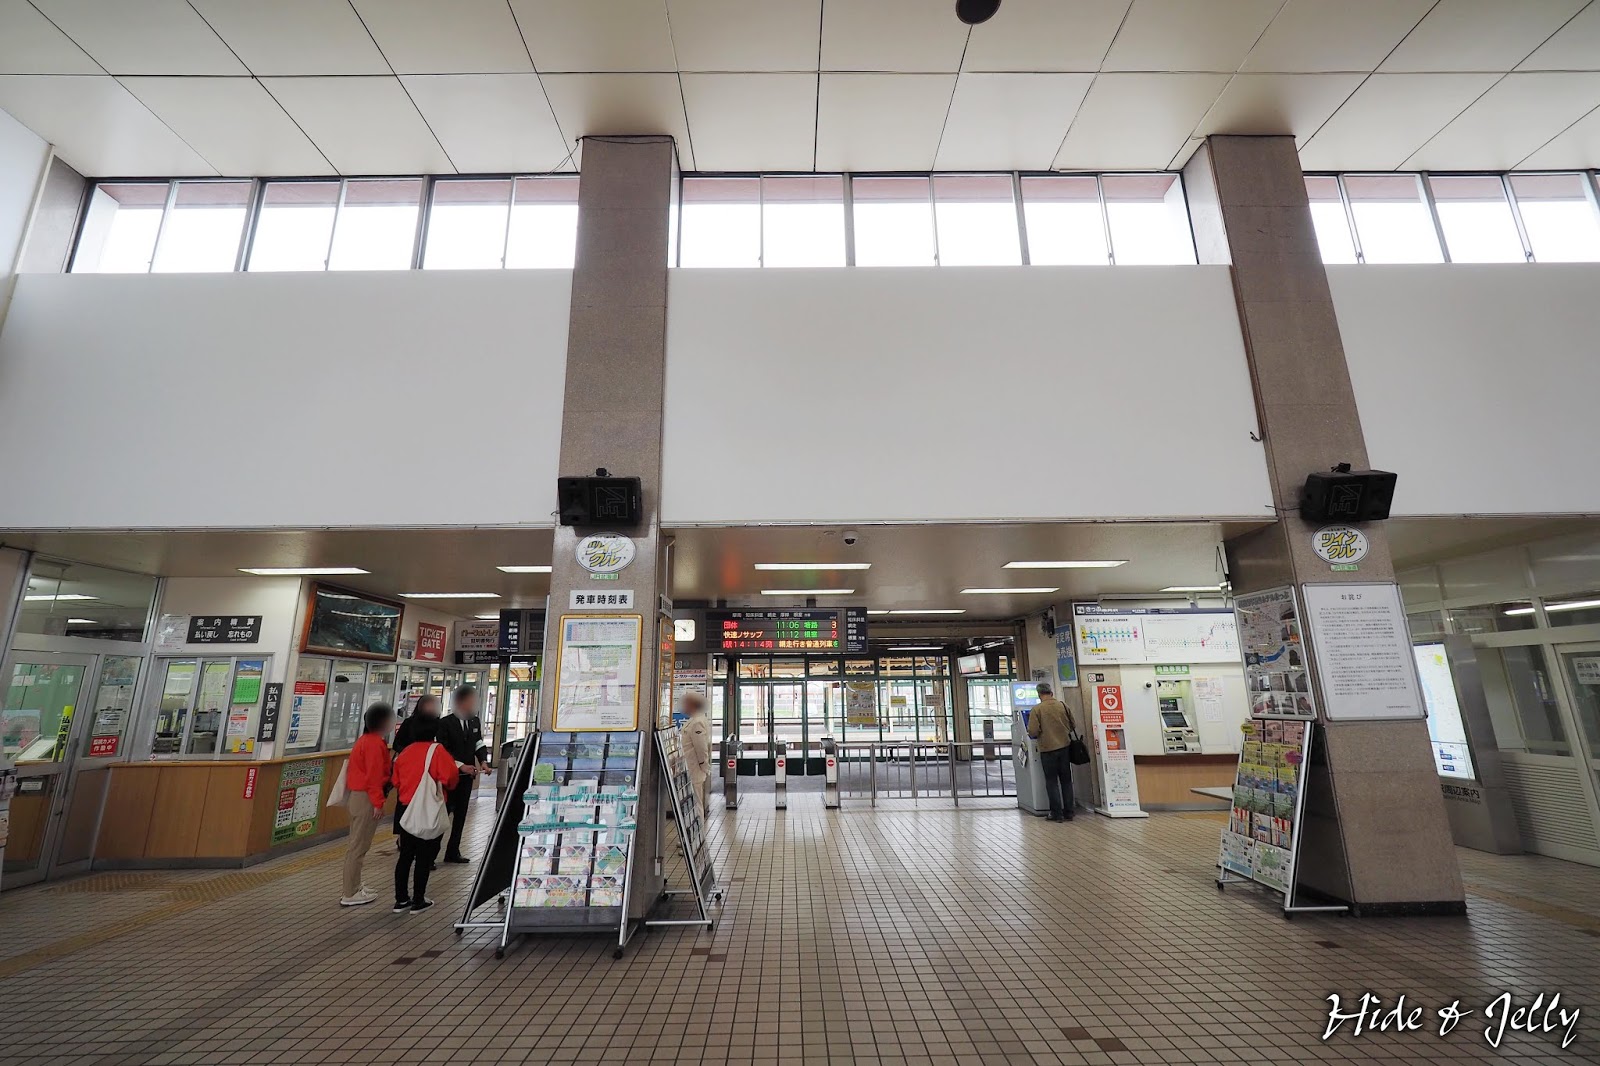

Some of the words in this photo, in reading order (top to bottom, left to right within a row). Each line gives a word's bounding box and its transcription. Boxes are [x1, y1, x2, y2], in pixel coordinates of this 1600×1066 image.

[575, 594, 628, 605] 発車時刻表
[723, 621, 738, 629] 団体
[776, 621, 800, 629] 11:06
[831, 621, 837, 629] 3
[419, 626, 445, 640] TICKET
[723, 630, 764, 639] 快速ノサップ
[776, 630, 800, 639] 11:12
[831, 630, 838, 639] 2
[421, 639, 441, 650] GATE
[262, 686, 278, 739] 払い戻し・精算
